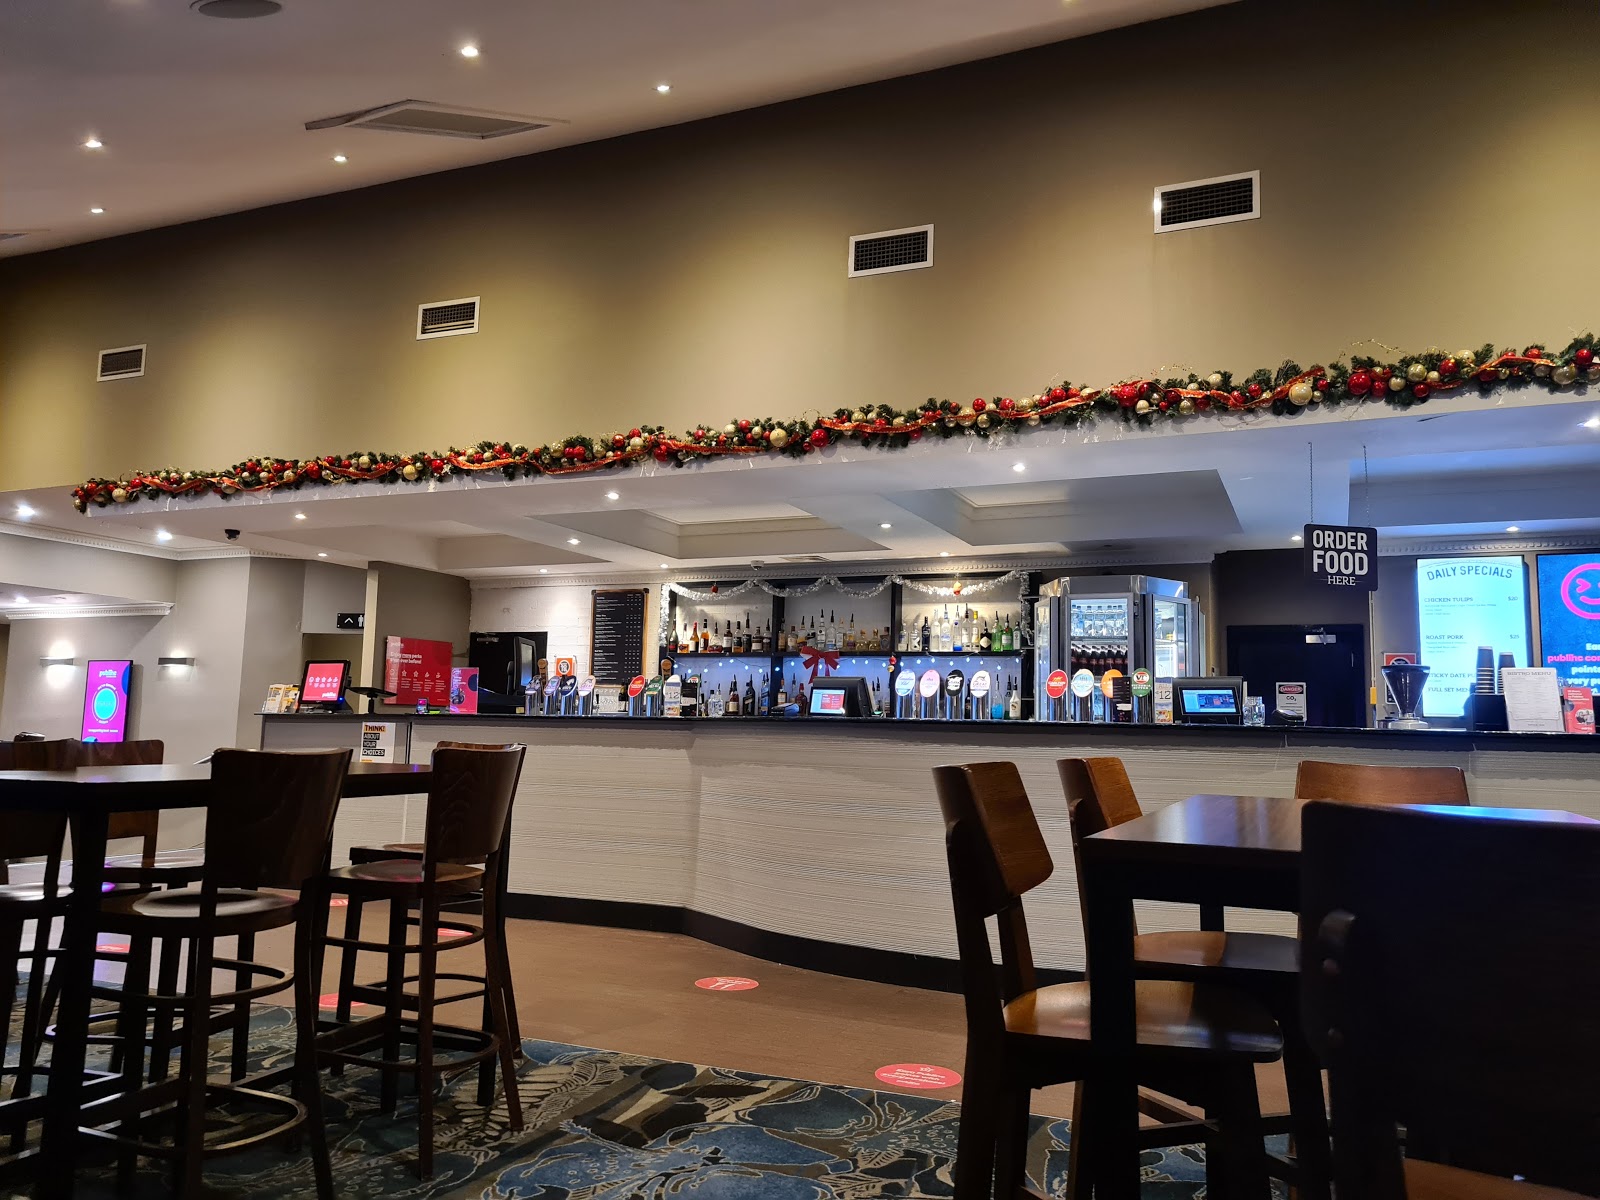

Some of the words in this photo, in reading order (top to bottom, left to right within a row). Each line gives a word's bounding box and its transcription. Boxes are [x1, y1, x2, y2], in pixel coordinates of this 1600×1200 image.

[1312, 529, 1368, 551] ORDER
[1312, 549, 1369, 576] FOOD
[1327, 575, 1356, 586] HERE
[1426, 566, 1457, 581] DAILY
[1460, 565, 1513, 579] SPECIALS
